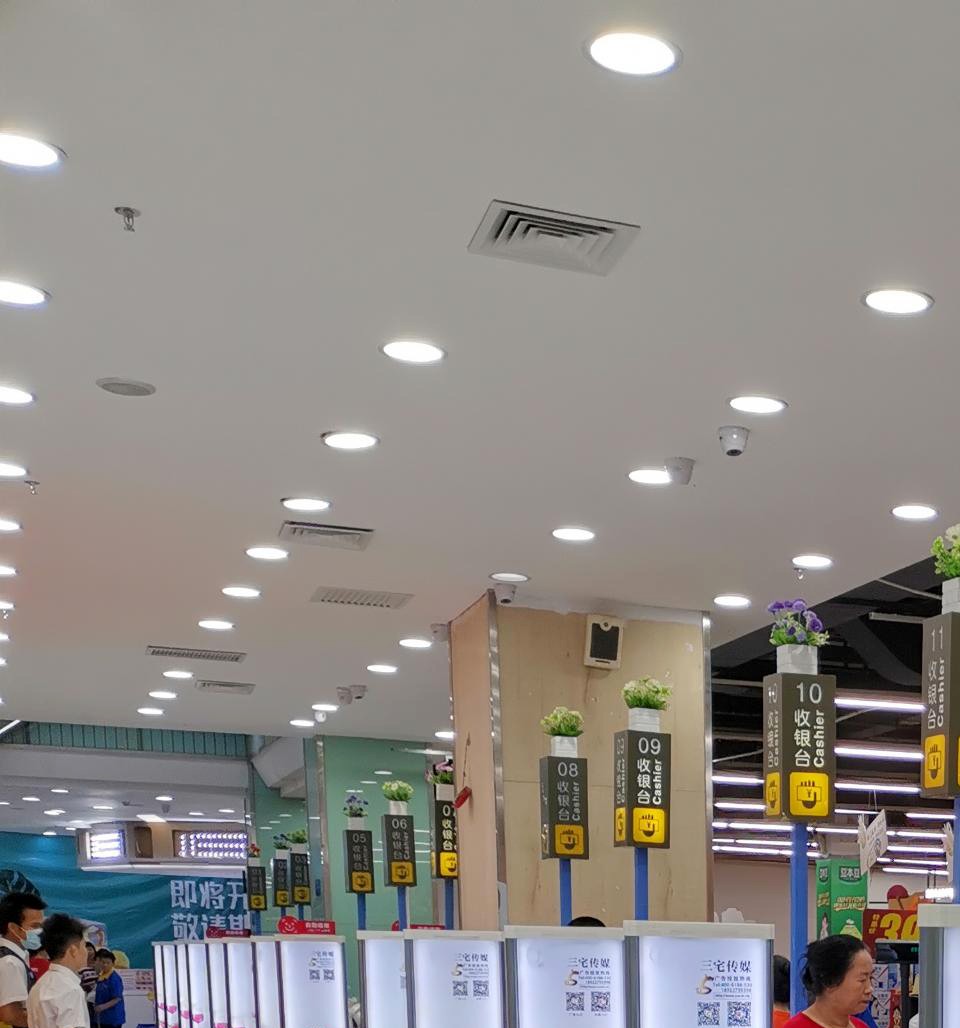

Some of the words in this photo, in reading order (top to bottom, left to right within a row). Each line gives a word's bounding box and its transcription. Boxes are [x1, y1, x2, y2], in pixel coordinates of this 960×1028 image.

[931, 625, 944, 651] 11
[796, 682, 822, 704] 10
[638, 737, 661, 755] 09
[794, 708, 811, 767] 收银台
[813, 709, 825, 768] Cashier
[557, 761, 579, 777] 08
[637, 758, 651, 805] 收银台
[652, 759, 662, 805] Cashier
[557, 780, 570, 821] 收银台
[572, 781, 580, 821] Cashier
[391, 818, 407, 829] 06
[442, 819, 453, 851] 收银台
[701, 960, 751, 973] 三宅传媒
